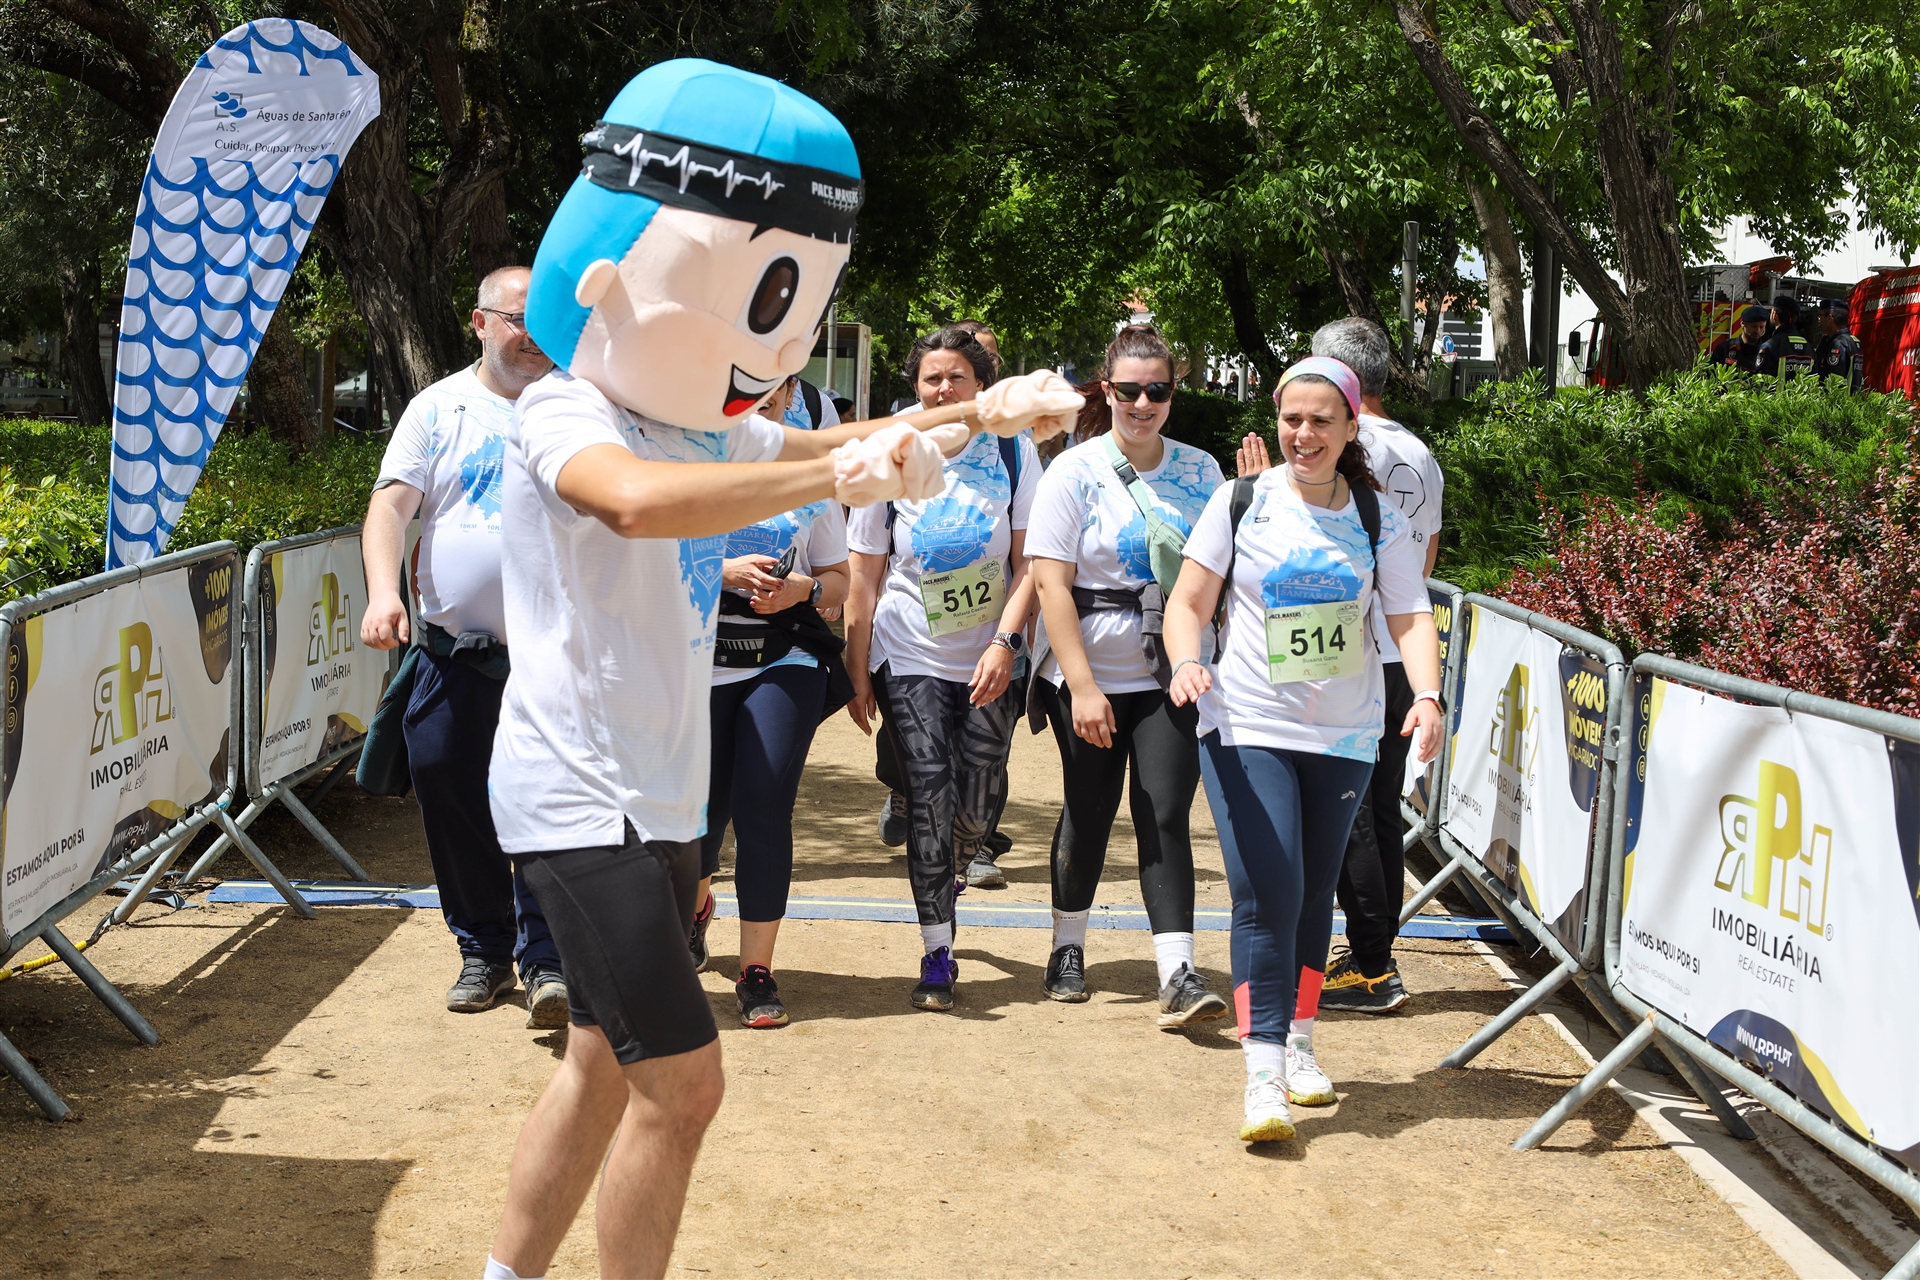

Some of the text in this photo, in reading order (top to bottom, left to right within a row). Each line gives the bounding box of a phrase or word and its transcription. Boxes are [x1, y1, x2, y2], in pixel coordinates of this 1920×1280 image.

[216, 121, 240, 132] A.S.
[256, 107, 289, 122] Águas
[292, 111, 305, 121] de
[214, 139, 252, 151] Cuidar.
[812, 181, 834, 200] PACE
[729, 530, 773, 540] ANTARÉM
[943, 581, 992, 613] 512
[1434, 603, 1451, 633] 1000
[1290, 624, 1346, 656] 514
[1567, 671, 1605, 713] +1000
[292, 719, 306, 734] POR
[90, 735, 169, 790] IMOBILIÁRIA
[1488, 768, 1532, 816] IMOBILIÁRIA
[6, 828, 85, 887] ESTAMOS AQUI POR SI
[1713, 759, 1833, 937] RPH
[1656, 938, 1676, 961] AQUI
[1676, 947, 1691, 970] POR
[1692, 957, 1700, 975] SI
[1712, 906, 1822, 983] IMOBILIÁRIA
[1337, 977, 1359, 987] balance
[1756, 964, 1795, 993] ESTATE
[1736, 1024, 1793, 1068] WWW.RPH.PT
